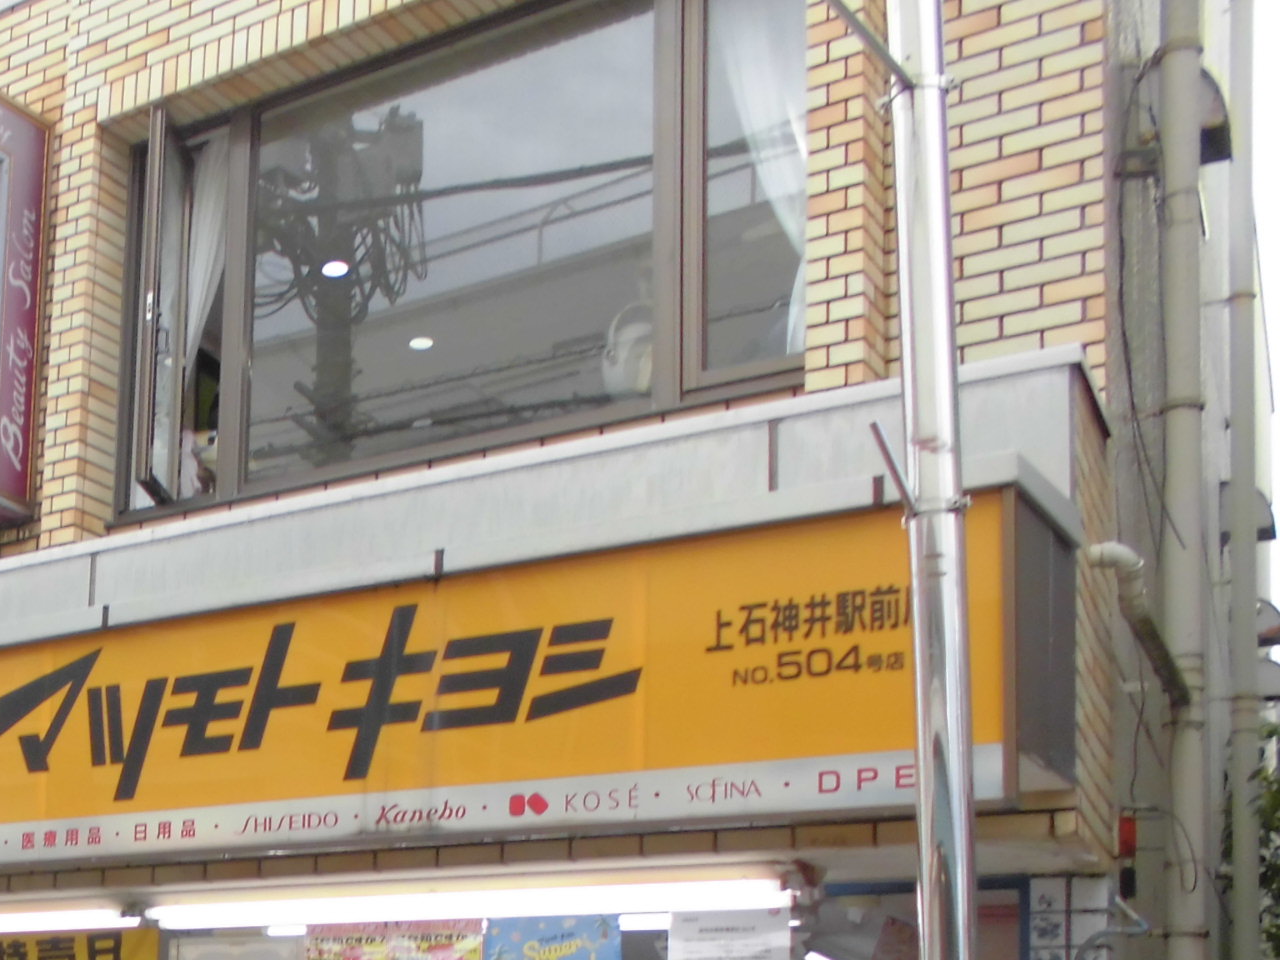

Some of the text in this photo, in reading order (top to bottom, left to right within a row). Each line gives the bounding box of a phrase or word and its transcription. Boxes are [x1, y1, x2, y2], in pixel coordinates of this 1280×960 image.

[0, 208, 37, 471] Beauty Salon
[705, 585, 914, 654] 上石神井駅前
[235, 811, 339, 834] SHISEIDO
[376, 800, 466, 827] Kanebo
[563, 783, 640, 815] KOSÉ
[686, 778, 762, 804] SOFINA
